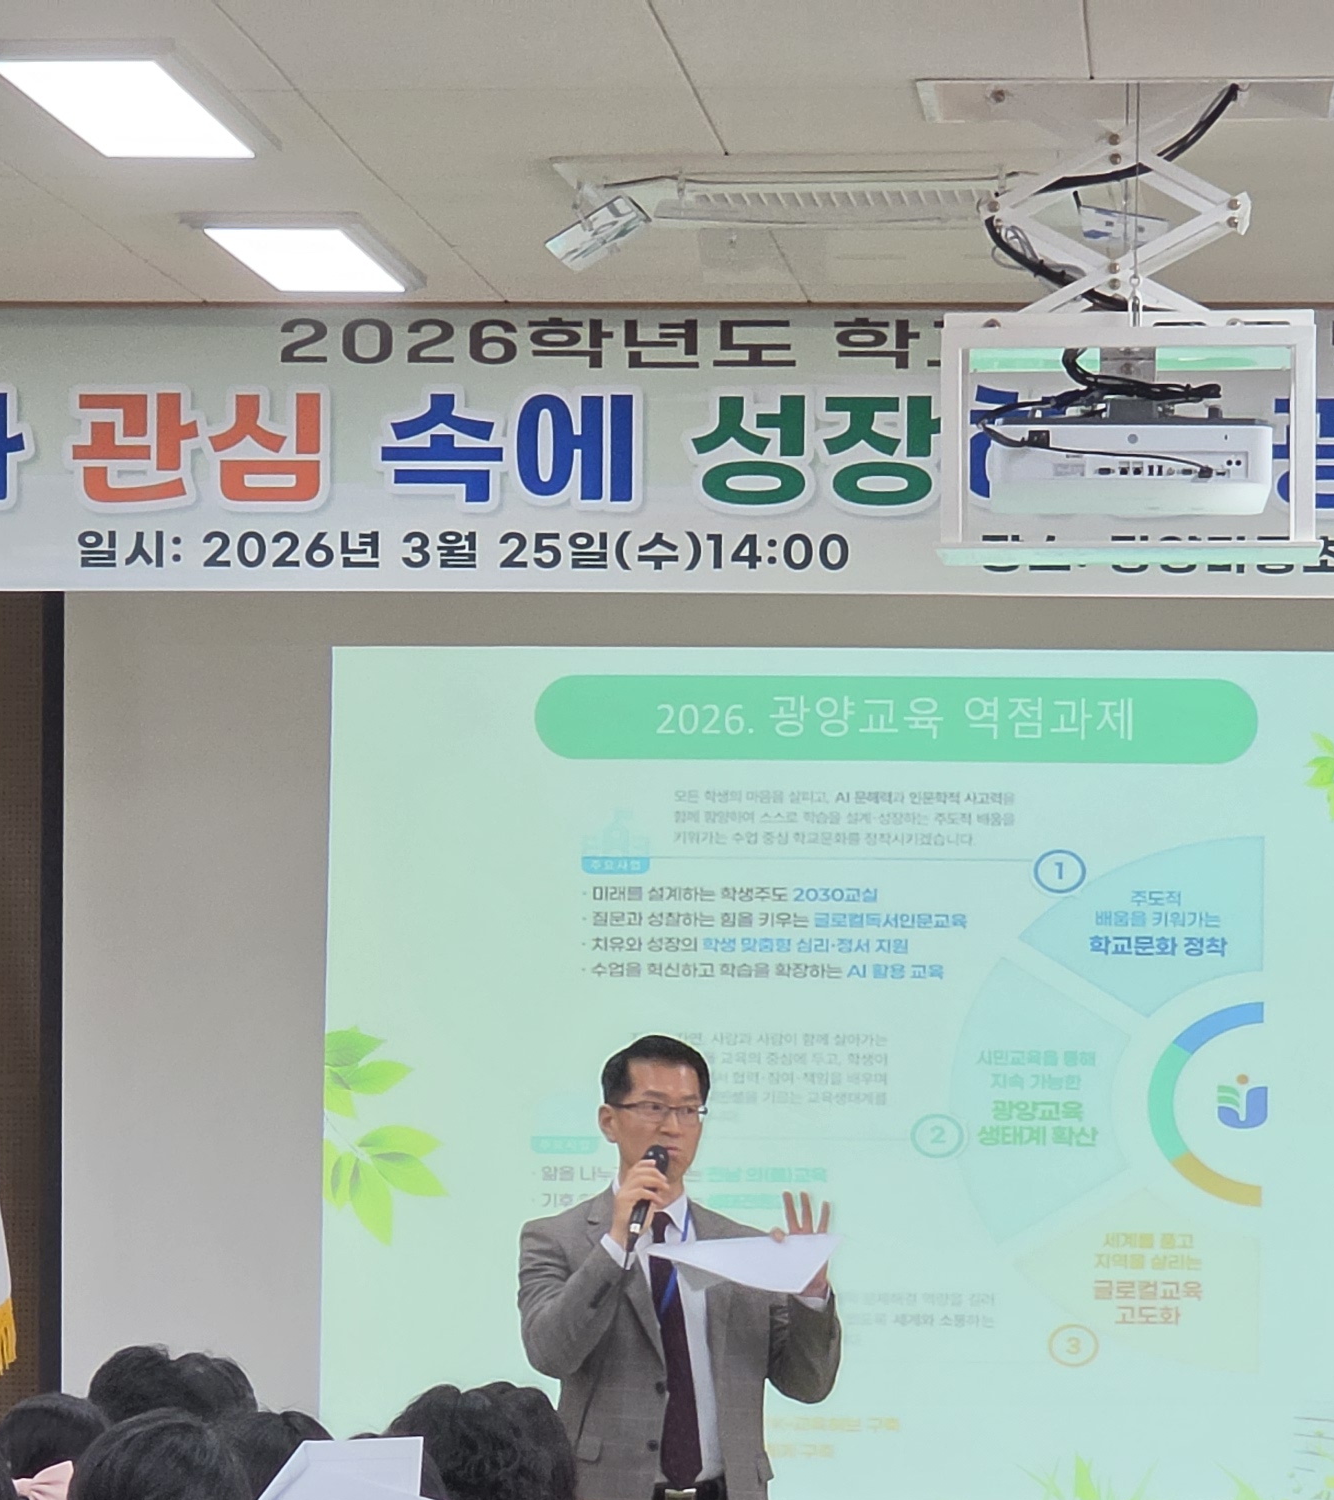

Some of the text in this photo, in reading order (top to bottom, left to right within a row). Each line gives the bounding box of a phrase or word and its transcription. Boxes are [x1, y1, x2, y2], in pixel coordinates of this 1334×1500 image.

[280, 317, 797, 369] 2026학년도
[72, 391, 322, 503] 관심
[380, 393, 634, 504] 속에
[77, 530, 183, 570] 일시:
[202, 530, 381, 569] 2026년
[401, 530, 479, 570] 3월
[498, 530, 850, 572] 25일(수)14:00
[655, 695, 1134, 741] 2026. 광양교육 역점과제
[704, 789, 742, 804] 학생의
[1053, 861, 1065, 881] 1
[592, 886, 878, 903] 미래를 설계하는 학생주도 2030교실
[1131, 890, 1182, 907] 주도적
[592, 911, 643, 927] 질문과
[758, 911, 810, 928] 키우는
[1095, 910, 1221, 928] 배움을 키워가는
[591, 936, 643, 952] 치유와
[647, 936, 698, 953] 성장의
[702, 937, 737, 953] 학생
[875, 938, 909, 955] 지원
[1089, 934, 1229, 958] 학교문화 정착
[591, 962, 642, 978] 수업을
[646, 962, 715, 978] 혁신하고
[720, 962, 770, 979] 학습을
[774, 963, 843, 979] 확장하는
[847, 964, 867, 979] AI
[910, 963, 945, 980] 교육
[990, 1073, 1025, 1090] 지속
[991, 1100, 1085, 1122] 광양교육
[930, 1126, 947, 1145] 2
[977, 1125, 1099, 1148] 생태계 확산
[1114, 1305, 1182, 1326] 고도화
[1066, 1336, 1082, 1355] 3
